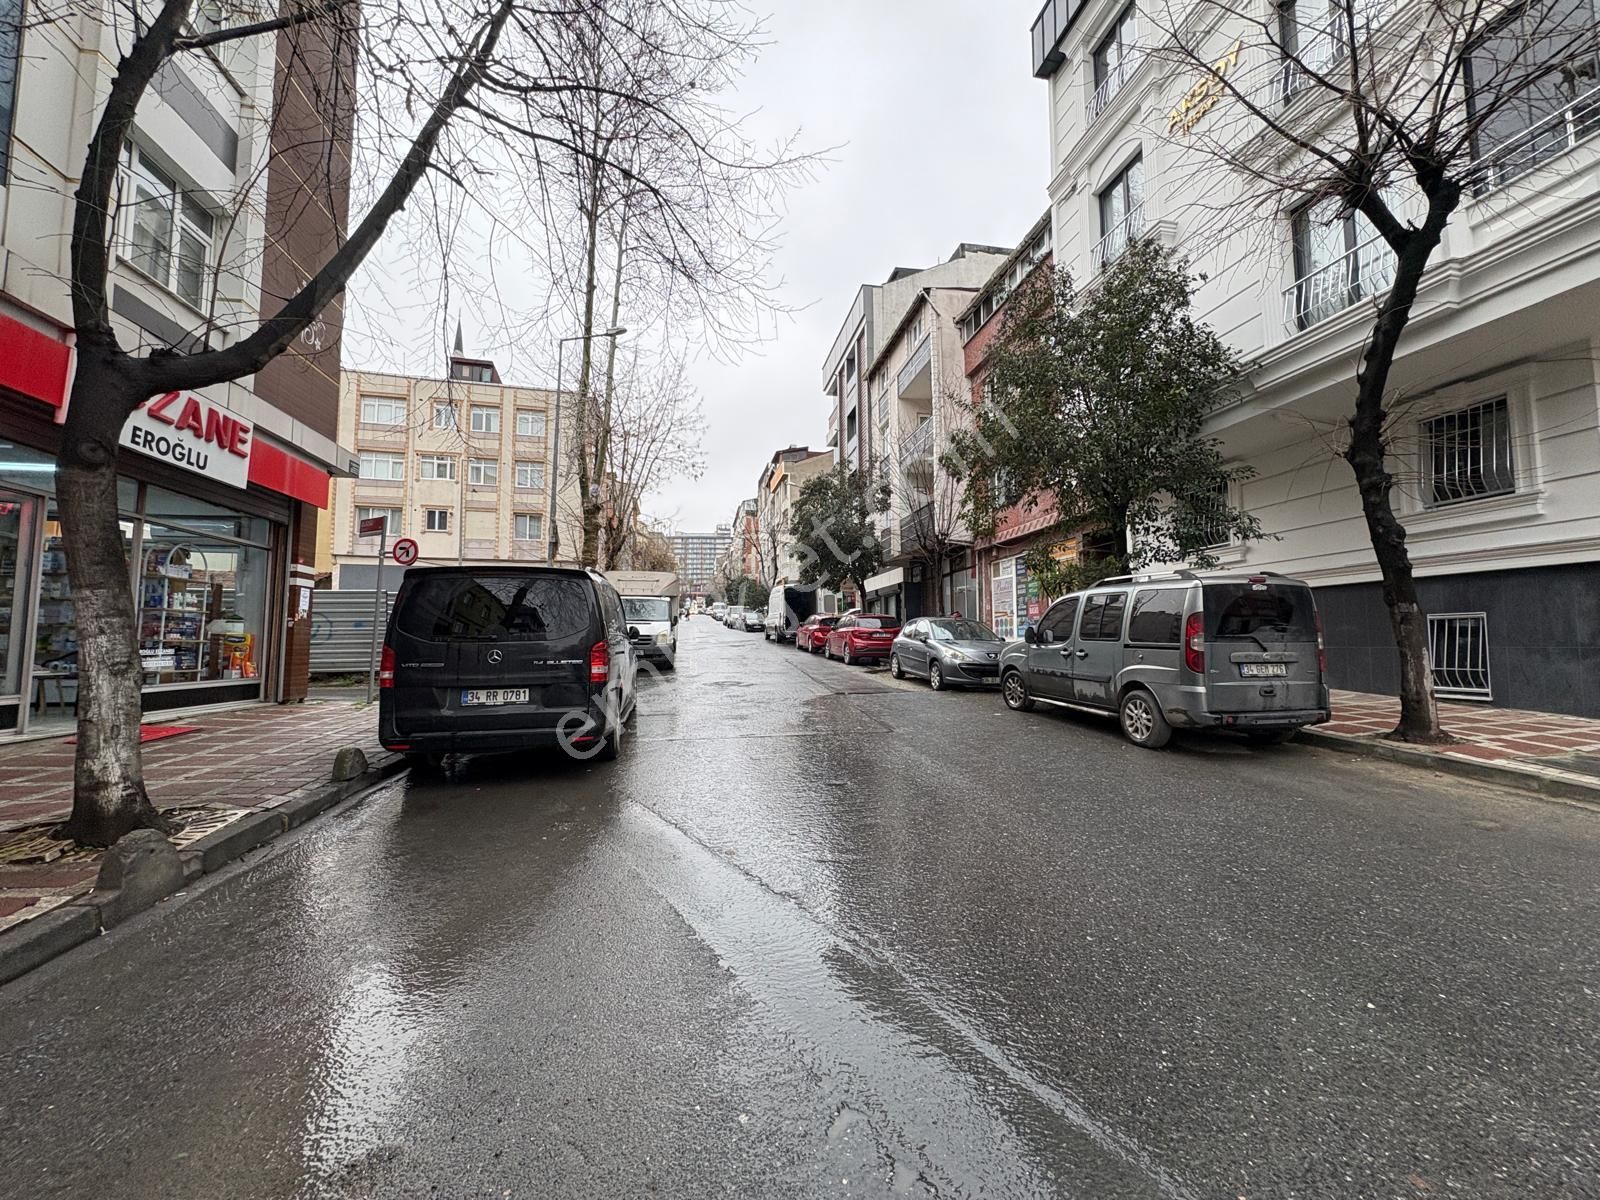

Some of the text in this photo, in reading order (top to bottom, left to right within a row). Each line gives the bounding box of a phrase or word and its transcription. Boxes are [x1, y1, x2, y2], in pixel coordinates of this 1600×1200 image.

[1166, 39, 1242, 134] AKSOY
[130, 425, 208, 470] EROĞLU
[138, 391, 250, 459] ZANE
[1245, 664, 1254, 673] 34
[469, 689, 527, 702] 34 RR 0781
